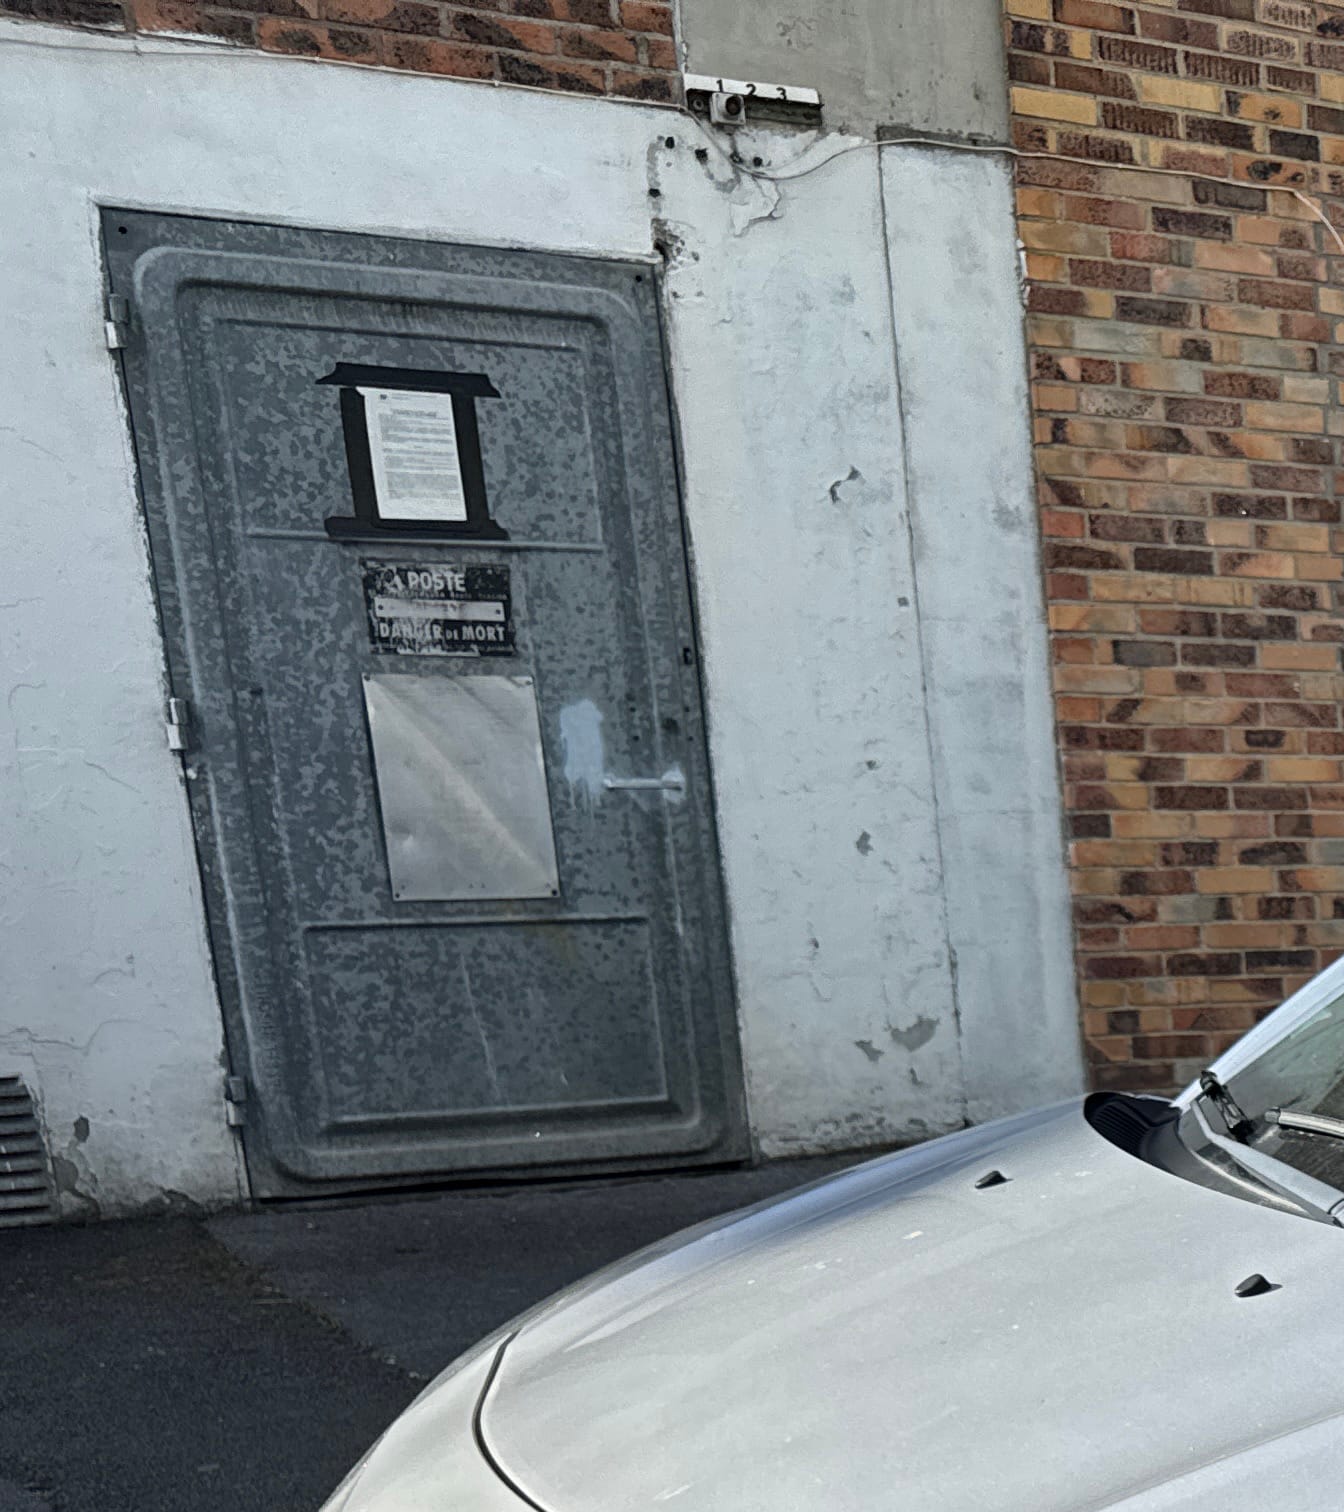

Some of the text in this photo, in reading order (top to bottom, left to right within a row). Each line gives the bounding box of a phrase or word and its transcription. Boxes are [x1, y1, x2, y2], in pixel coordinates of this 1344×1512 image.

[716, 79, 787, 100] 1 2 3
[407, 571, 466, 591] POSTE
[380, 622, 442, 640] DANGER
[462, 624, 505, 641] MORT
